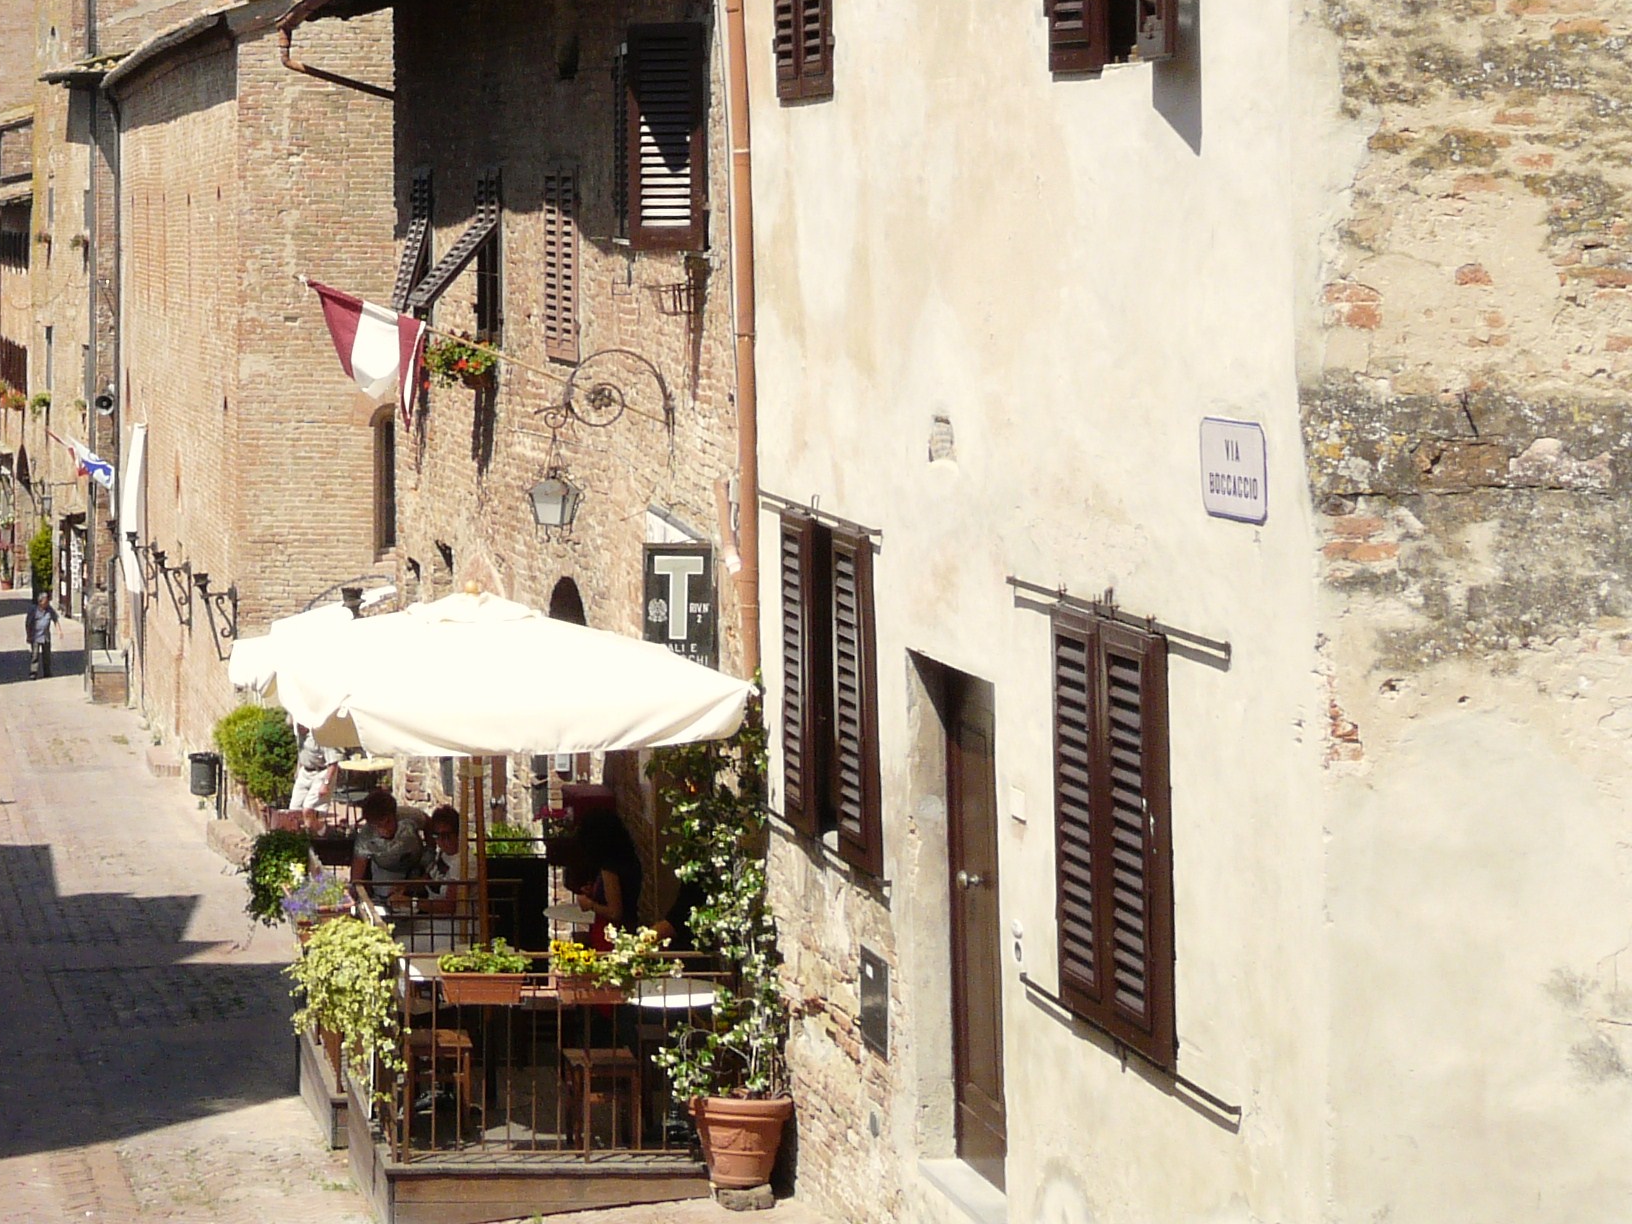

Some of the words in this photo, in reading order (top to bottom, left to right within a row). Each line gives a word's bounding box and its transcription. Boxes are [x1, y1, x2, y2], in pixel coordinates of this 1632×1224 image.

[1224, 439, 1240, 462] VIA
[1209, 472, 1258, 500] BOCCACCIO
[654, 556, 704, 640] T
[696, 614, 703, 623] 2
[668, 643, 685, 653] ALI
[690, 643, 698, 653] E
